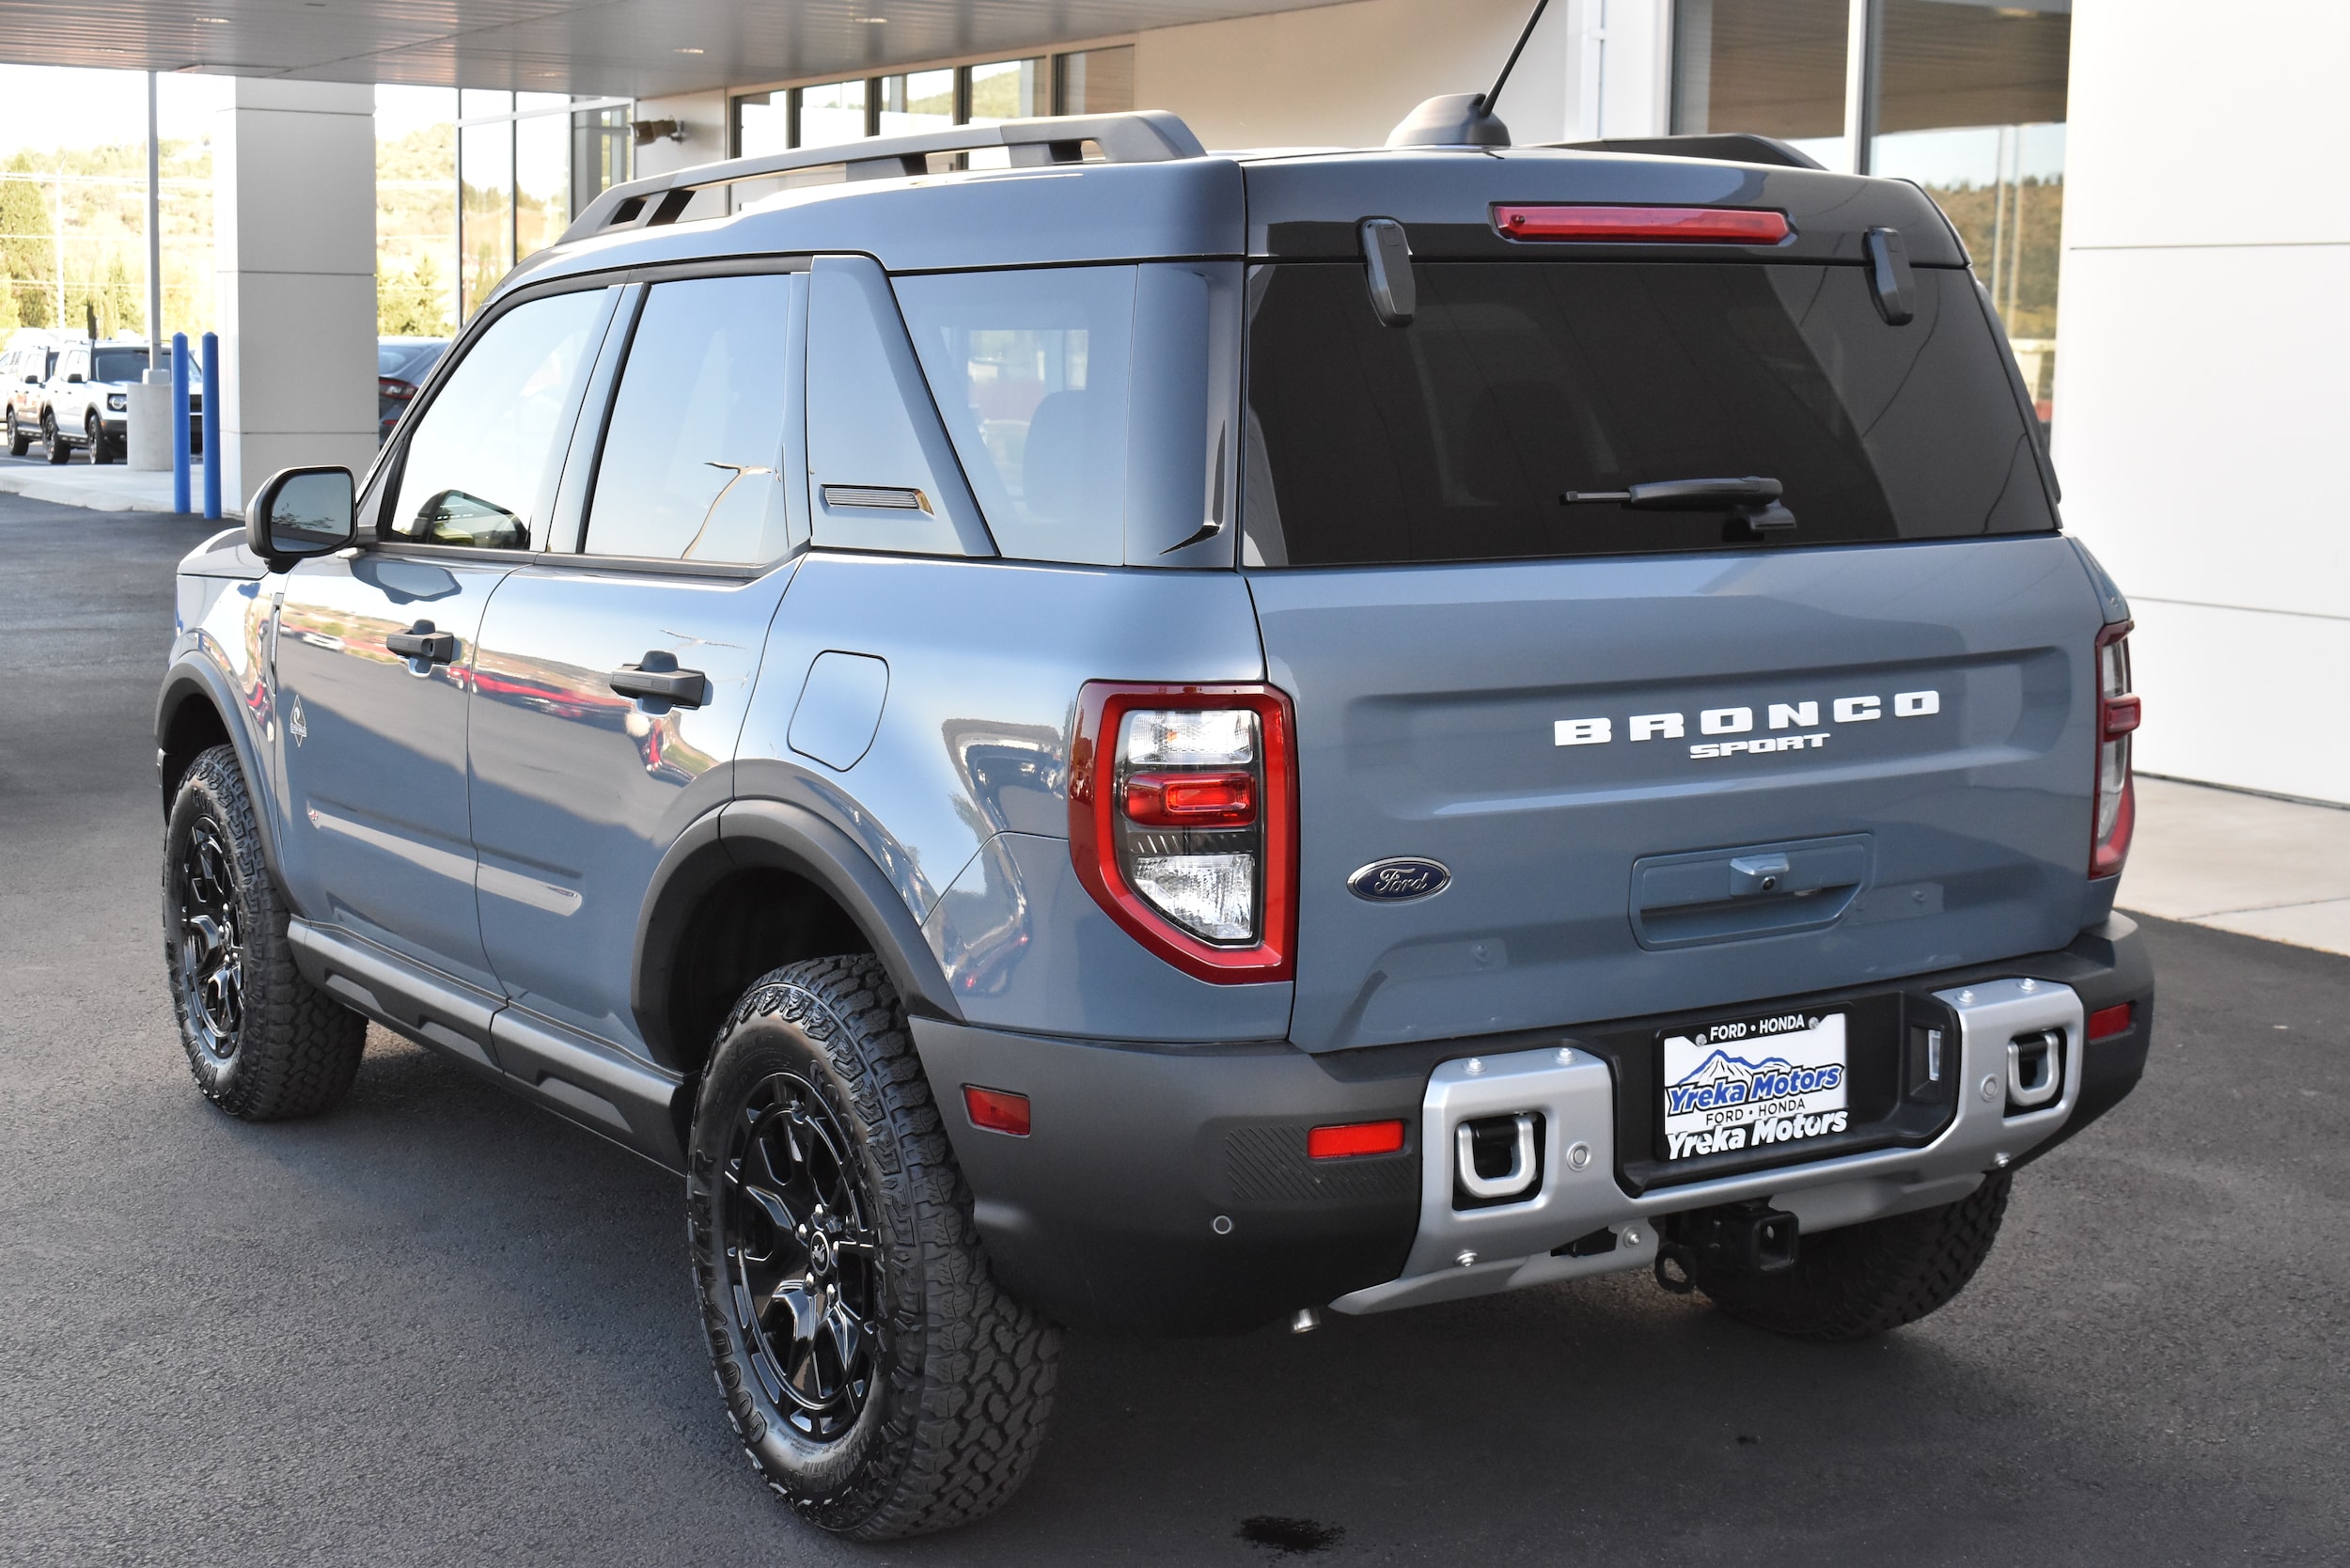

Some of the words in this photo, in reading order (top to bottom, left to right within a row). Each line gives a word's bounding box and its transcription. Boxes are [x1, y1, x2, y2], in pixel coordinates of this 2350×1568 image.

[1554, 690, 1940, 746] BRONCO
[1689, 733, 1831, 760] SPORT
[1373, 867, 1430, 894] Ford
[1710, 1025, 1747, 1042] FORD
[1759, 1014, 1805, 1034] HONDA
[1668, 1078, 1747, 1115] Yreka
[1750, 1065, 1842, 1101] Motors
[1706, 1108, 1744, 1125] FORD
[1758, 1097, 1806, 1117] HONDA
[1667, 1124, 1747, 1160] Yreka
[1751, 1110, 1849, 1146] Motors
